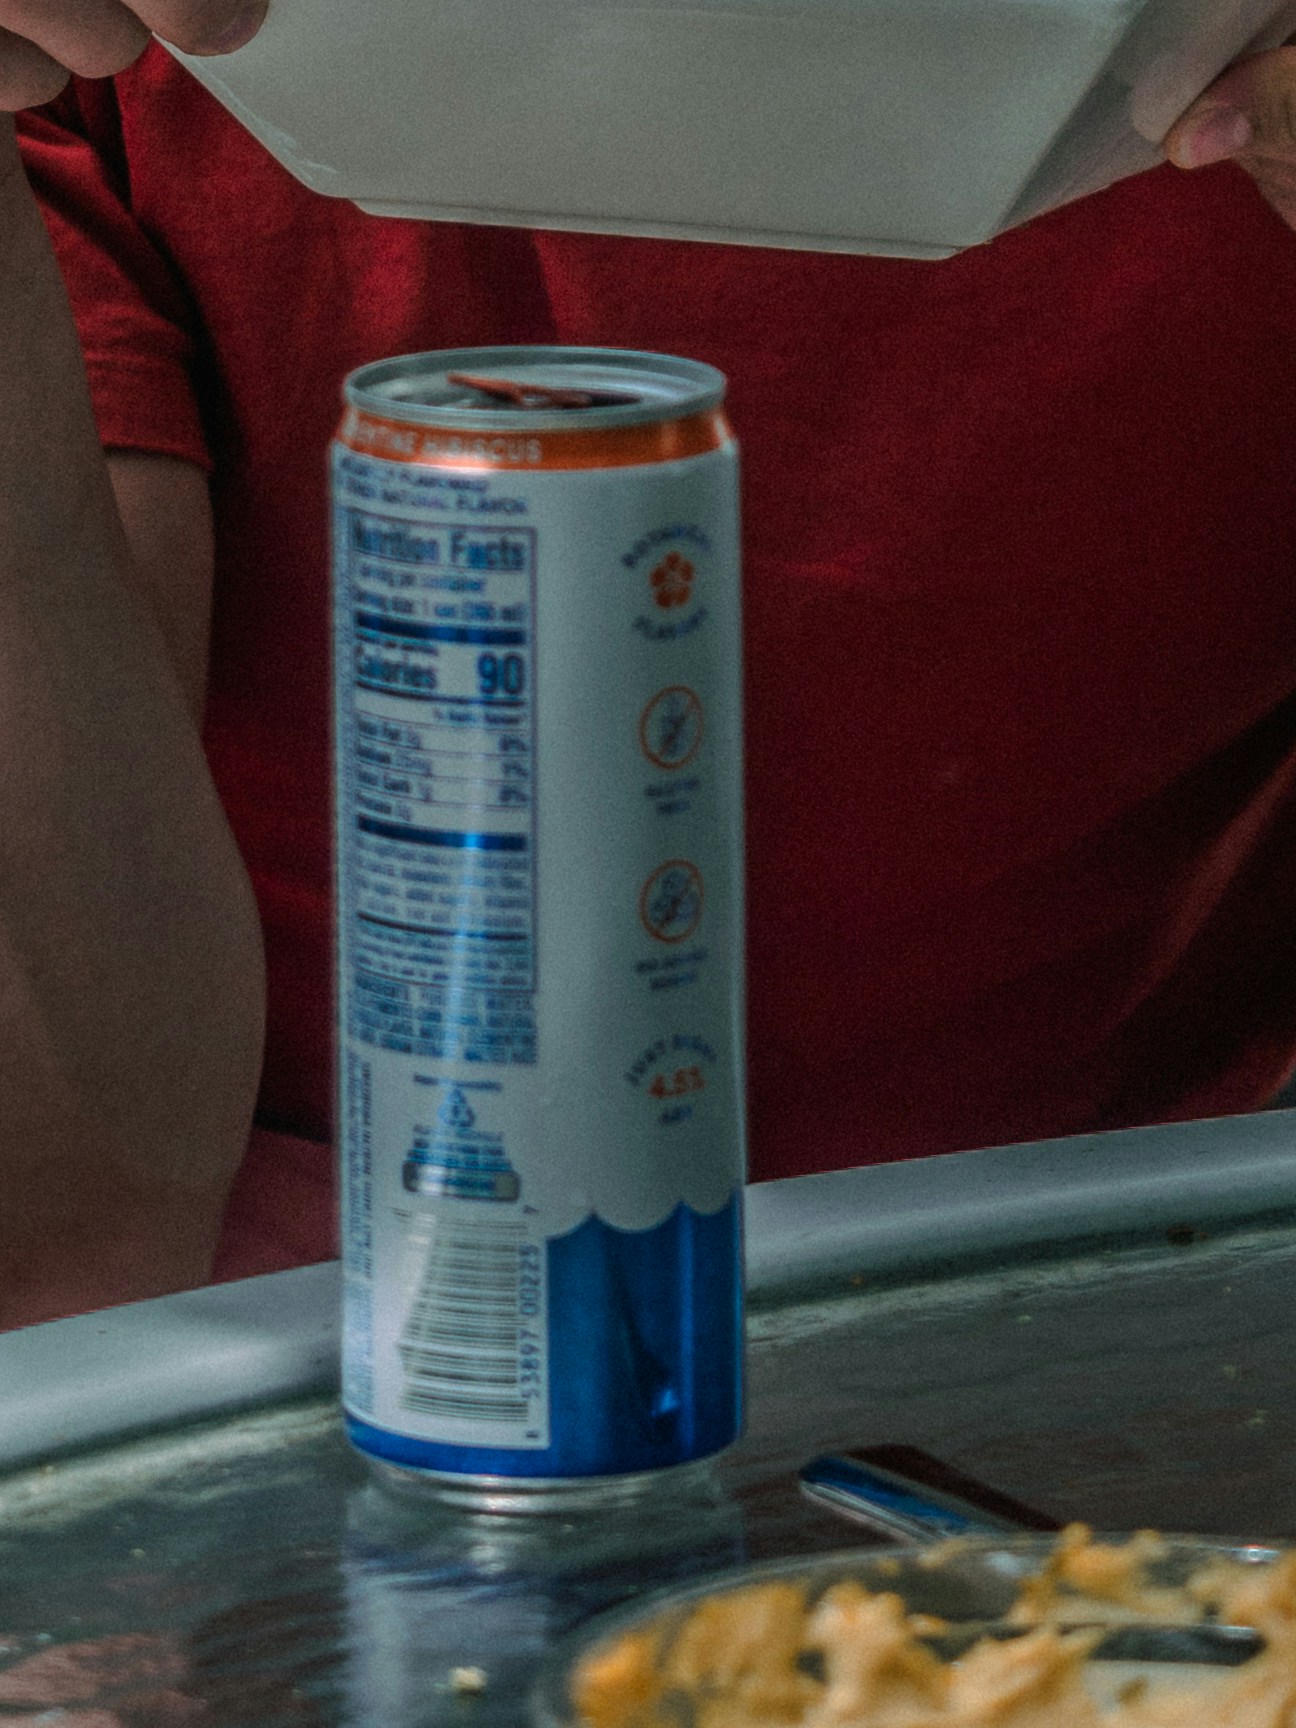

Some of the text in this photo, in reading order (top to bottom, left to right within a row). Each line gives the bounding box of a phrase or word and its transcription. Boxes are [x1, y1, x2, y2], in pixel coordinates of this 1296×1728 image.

[353, 518, 525, 569] Nutrition Facts
[355, 645, 526, 696] Calories 90
